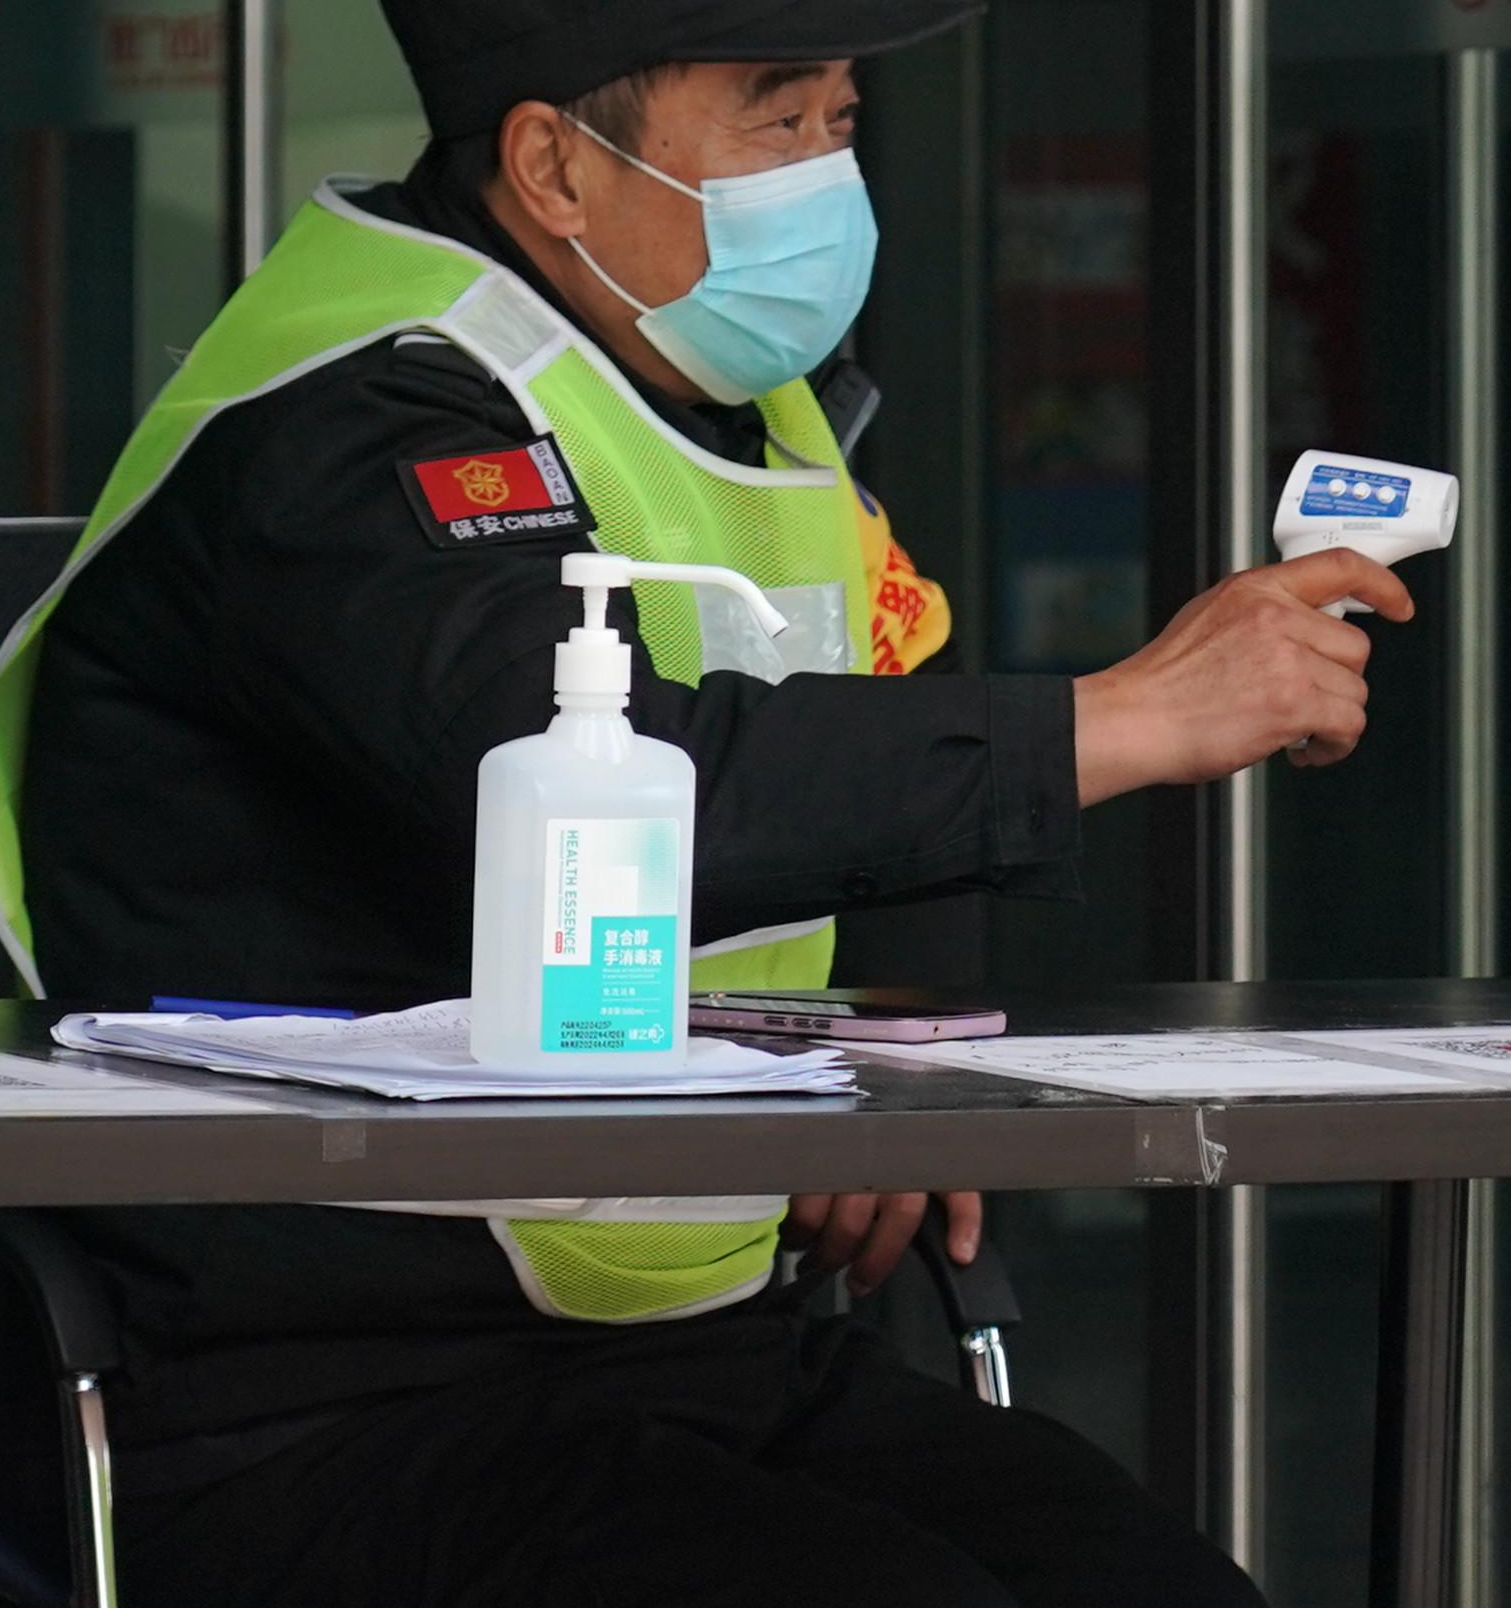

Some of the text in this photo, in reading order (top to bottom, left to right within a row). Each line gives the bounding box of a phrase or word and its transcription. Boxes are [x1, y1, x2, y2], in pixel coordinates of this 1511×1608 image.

[563, 829, 579, 955] HEALTH ESSENCE
[603, 948, 663, 966] 手消毒液
